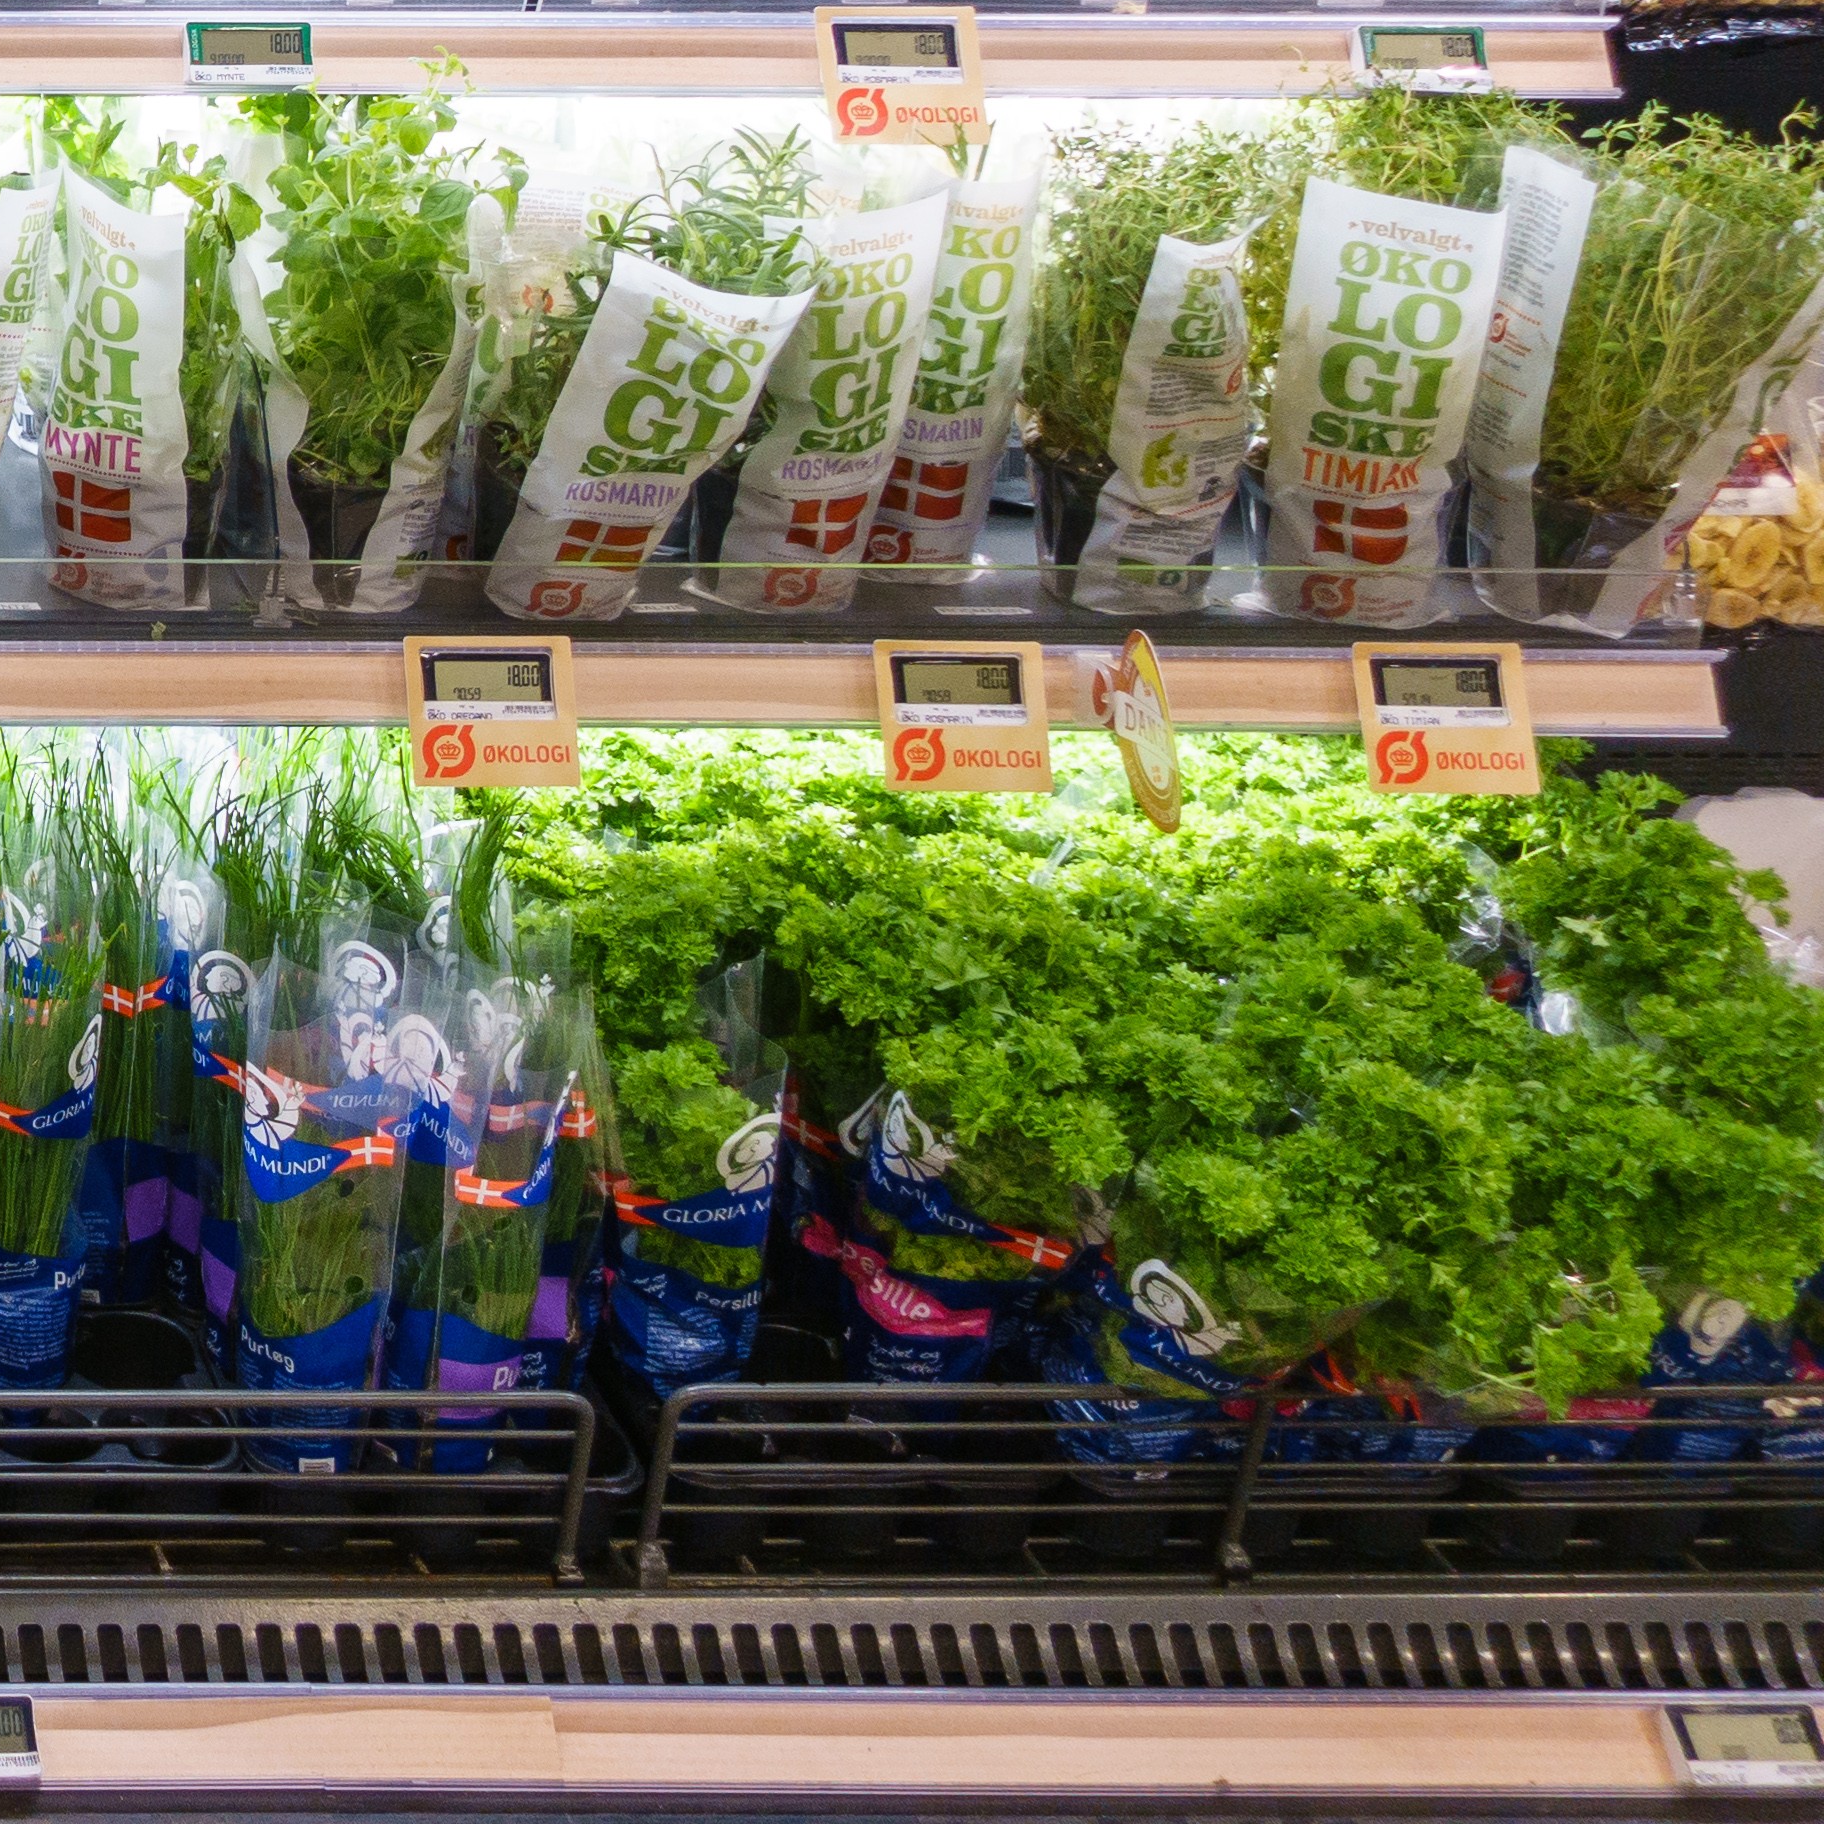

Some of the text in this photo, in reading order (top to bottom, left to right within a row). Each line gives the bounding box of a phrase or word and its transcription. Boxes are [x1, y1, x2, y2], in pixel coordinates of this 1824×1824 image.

[215, 72, 246, 81] MYNTE
[895, 105, 980, 125] ØKOLOGI
[1361, 219, 1463, 252] velvalgt
[1339, 240, 1472, 294] ØKO
[1328, 276, 1463, 351] LO
[1317, 347, 1445, 420] GI
[45, 420, 143, 473] MYNTE
[1301, 447, 1425, 492] TIMIAN
[565, 479, 680, 510] ROSMARIN
[1380, 716, 1442, 726] ØKO TIMIAN
[483, 744, 572, 764] ØKOLOGI
[952, 748, 1042, 768] ØKOLOGI
[1435, 750, 1527, 771] ØKOLOGI
[261, 1154, 327, 1177] MUNDI
